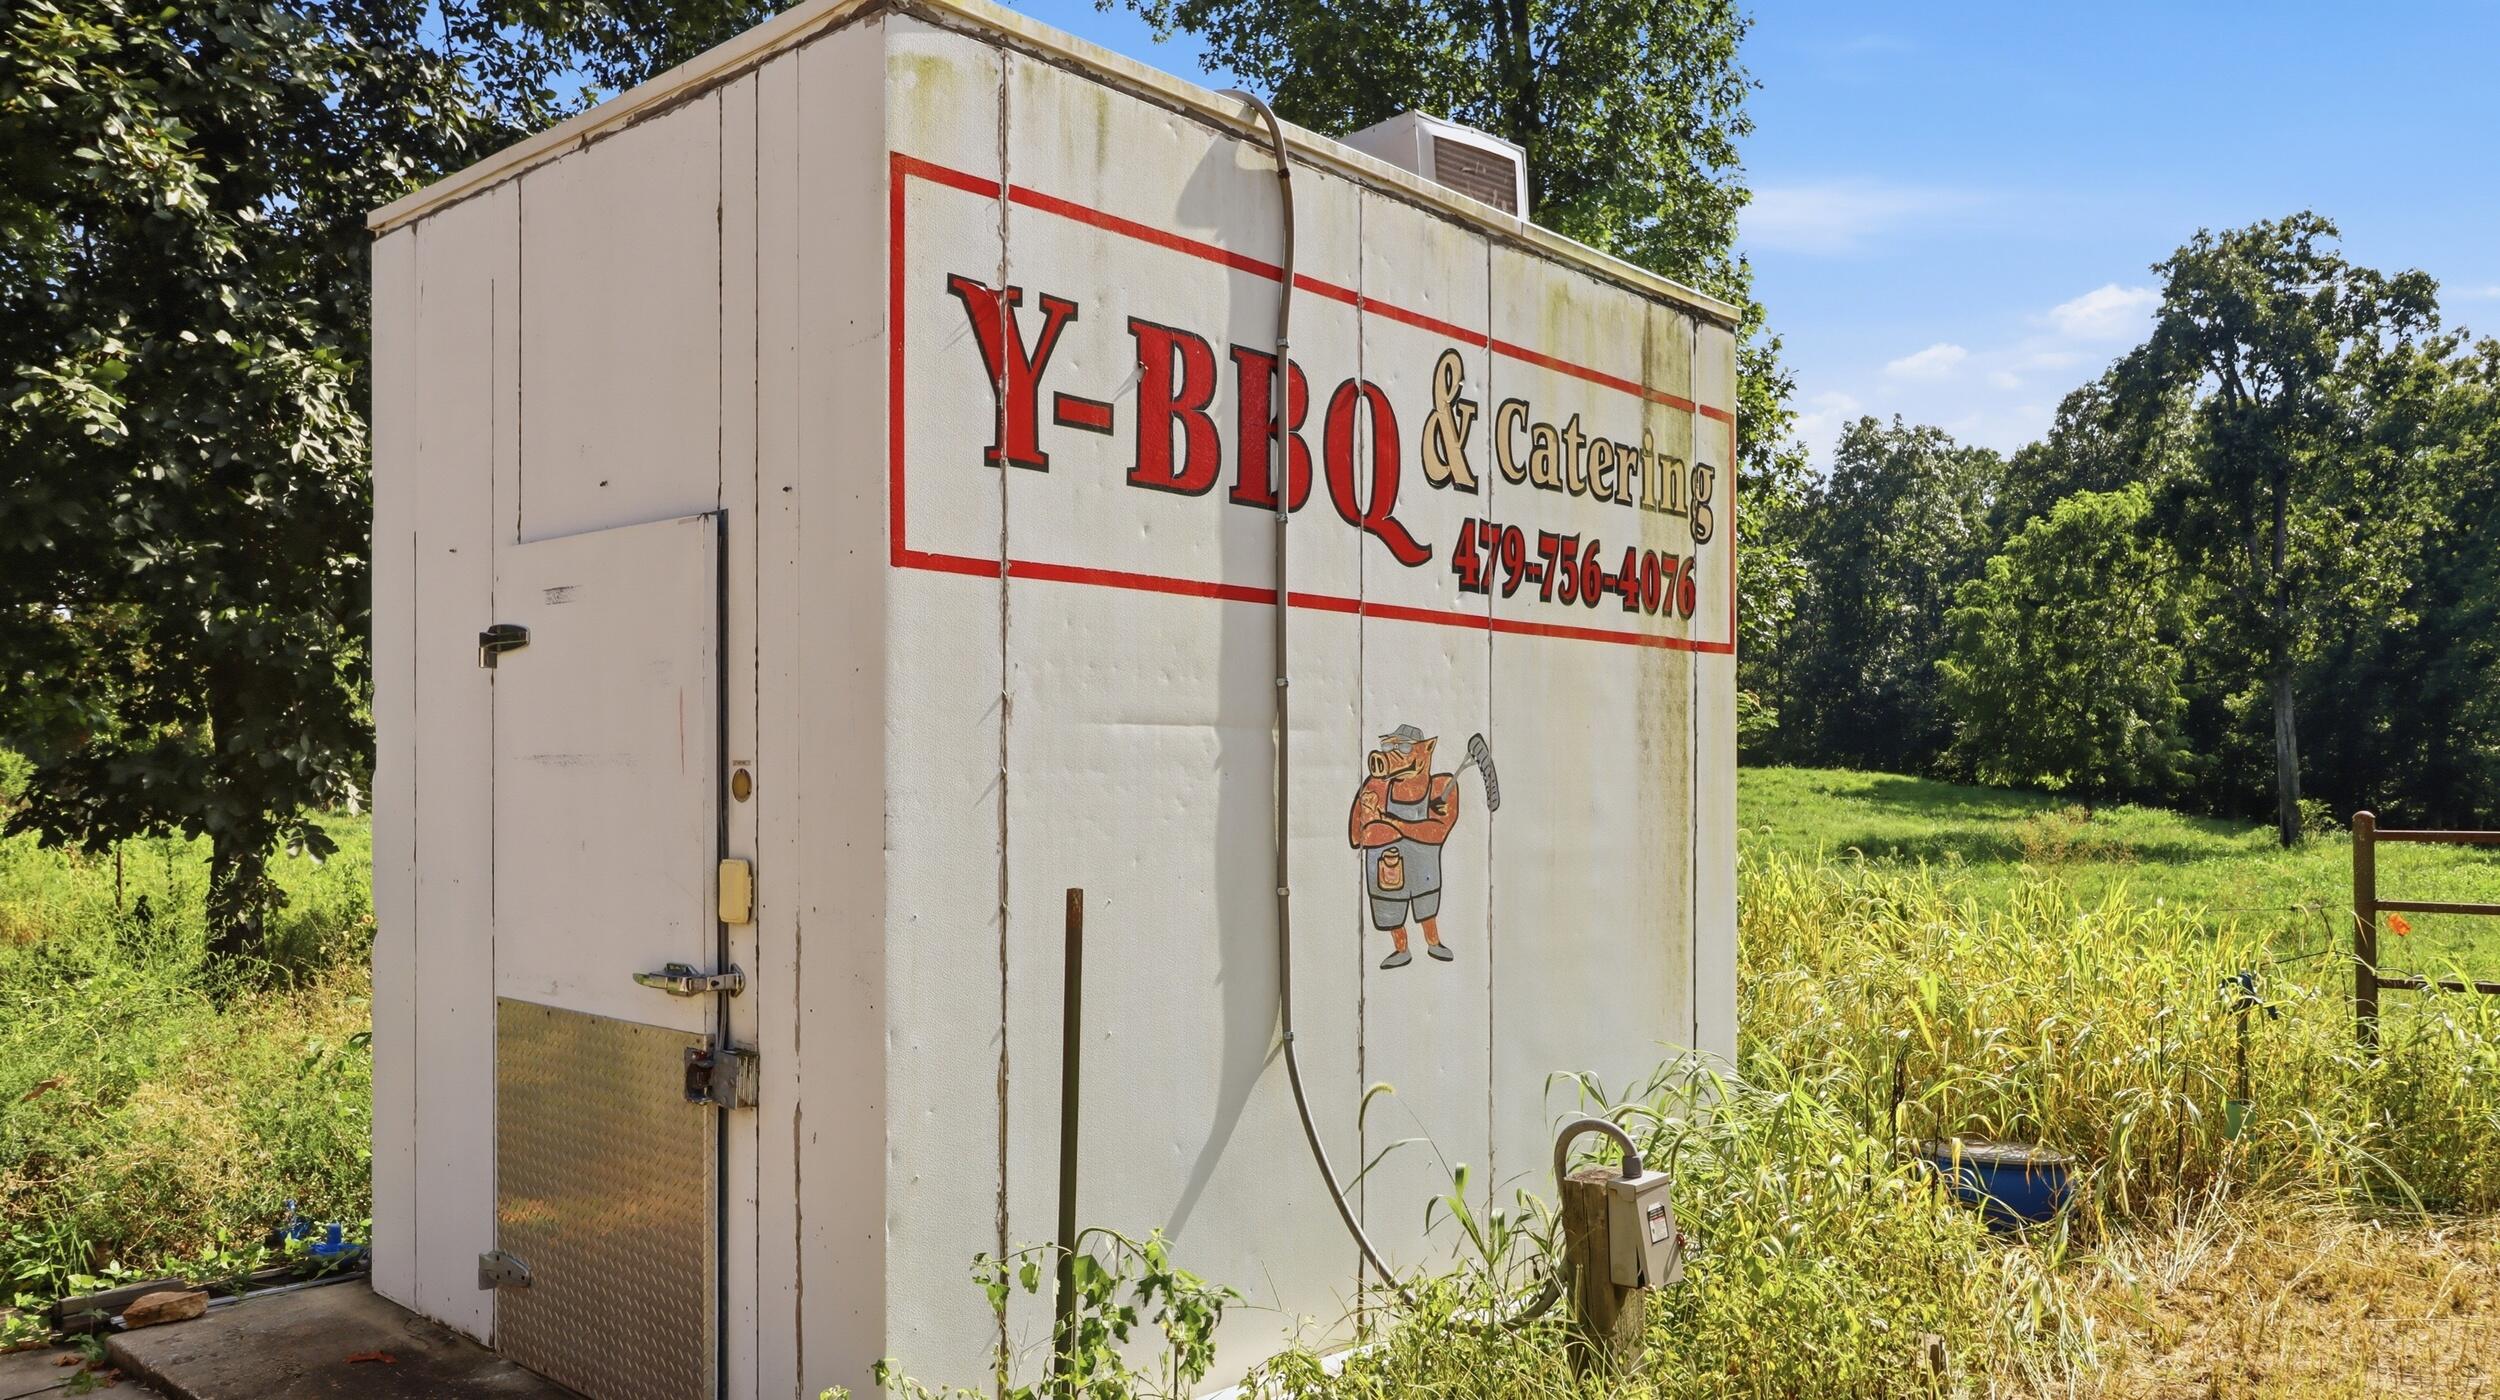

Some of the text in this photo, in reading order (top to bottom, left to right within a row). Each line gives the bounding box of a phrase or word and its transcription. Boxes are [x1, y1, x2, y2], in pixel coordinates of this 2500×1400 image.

[947, 272, 1715, 567] Y-BBQ & Catering
[1452, 517, 1696, 620] 479-756-4076
